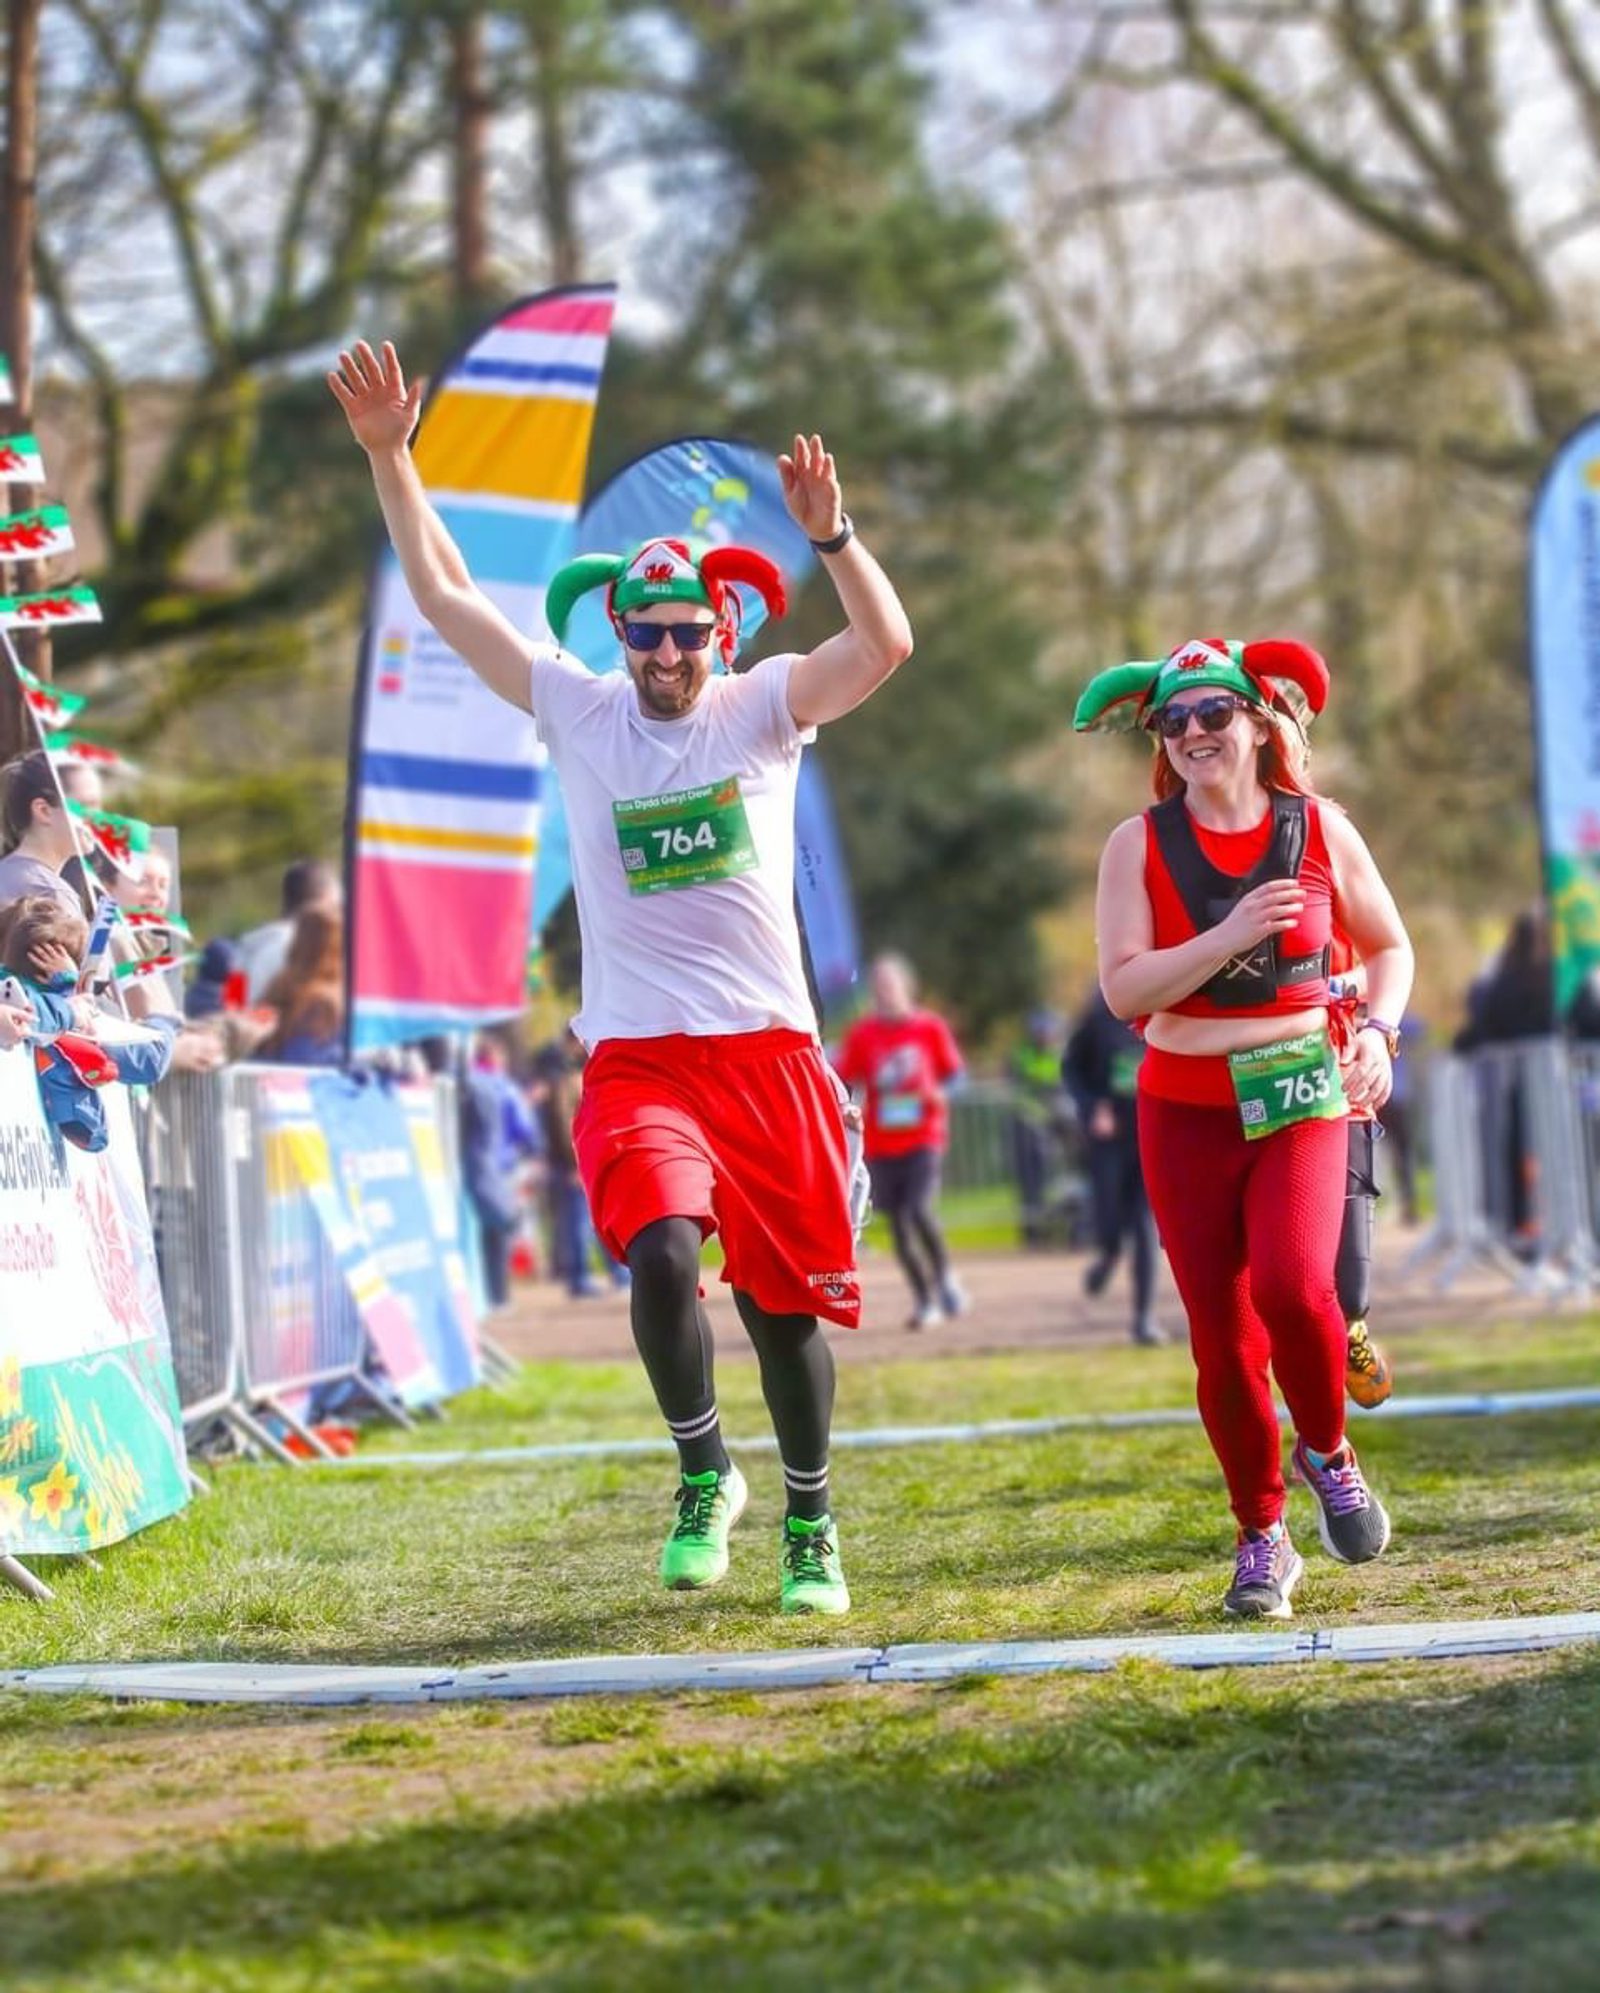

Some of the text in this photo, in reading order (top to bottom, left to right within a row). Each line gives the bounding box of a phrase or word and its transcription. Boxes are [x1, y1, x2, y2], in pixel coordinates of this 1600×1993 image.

[651, 821, 717, 859] 764
[1291, 957, 1323, 973] NXT
[1274, 1067, 1330, 1110] 763
